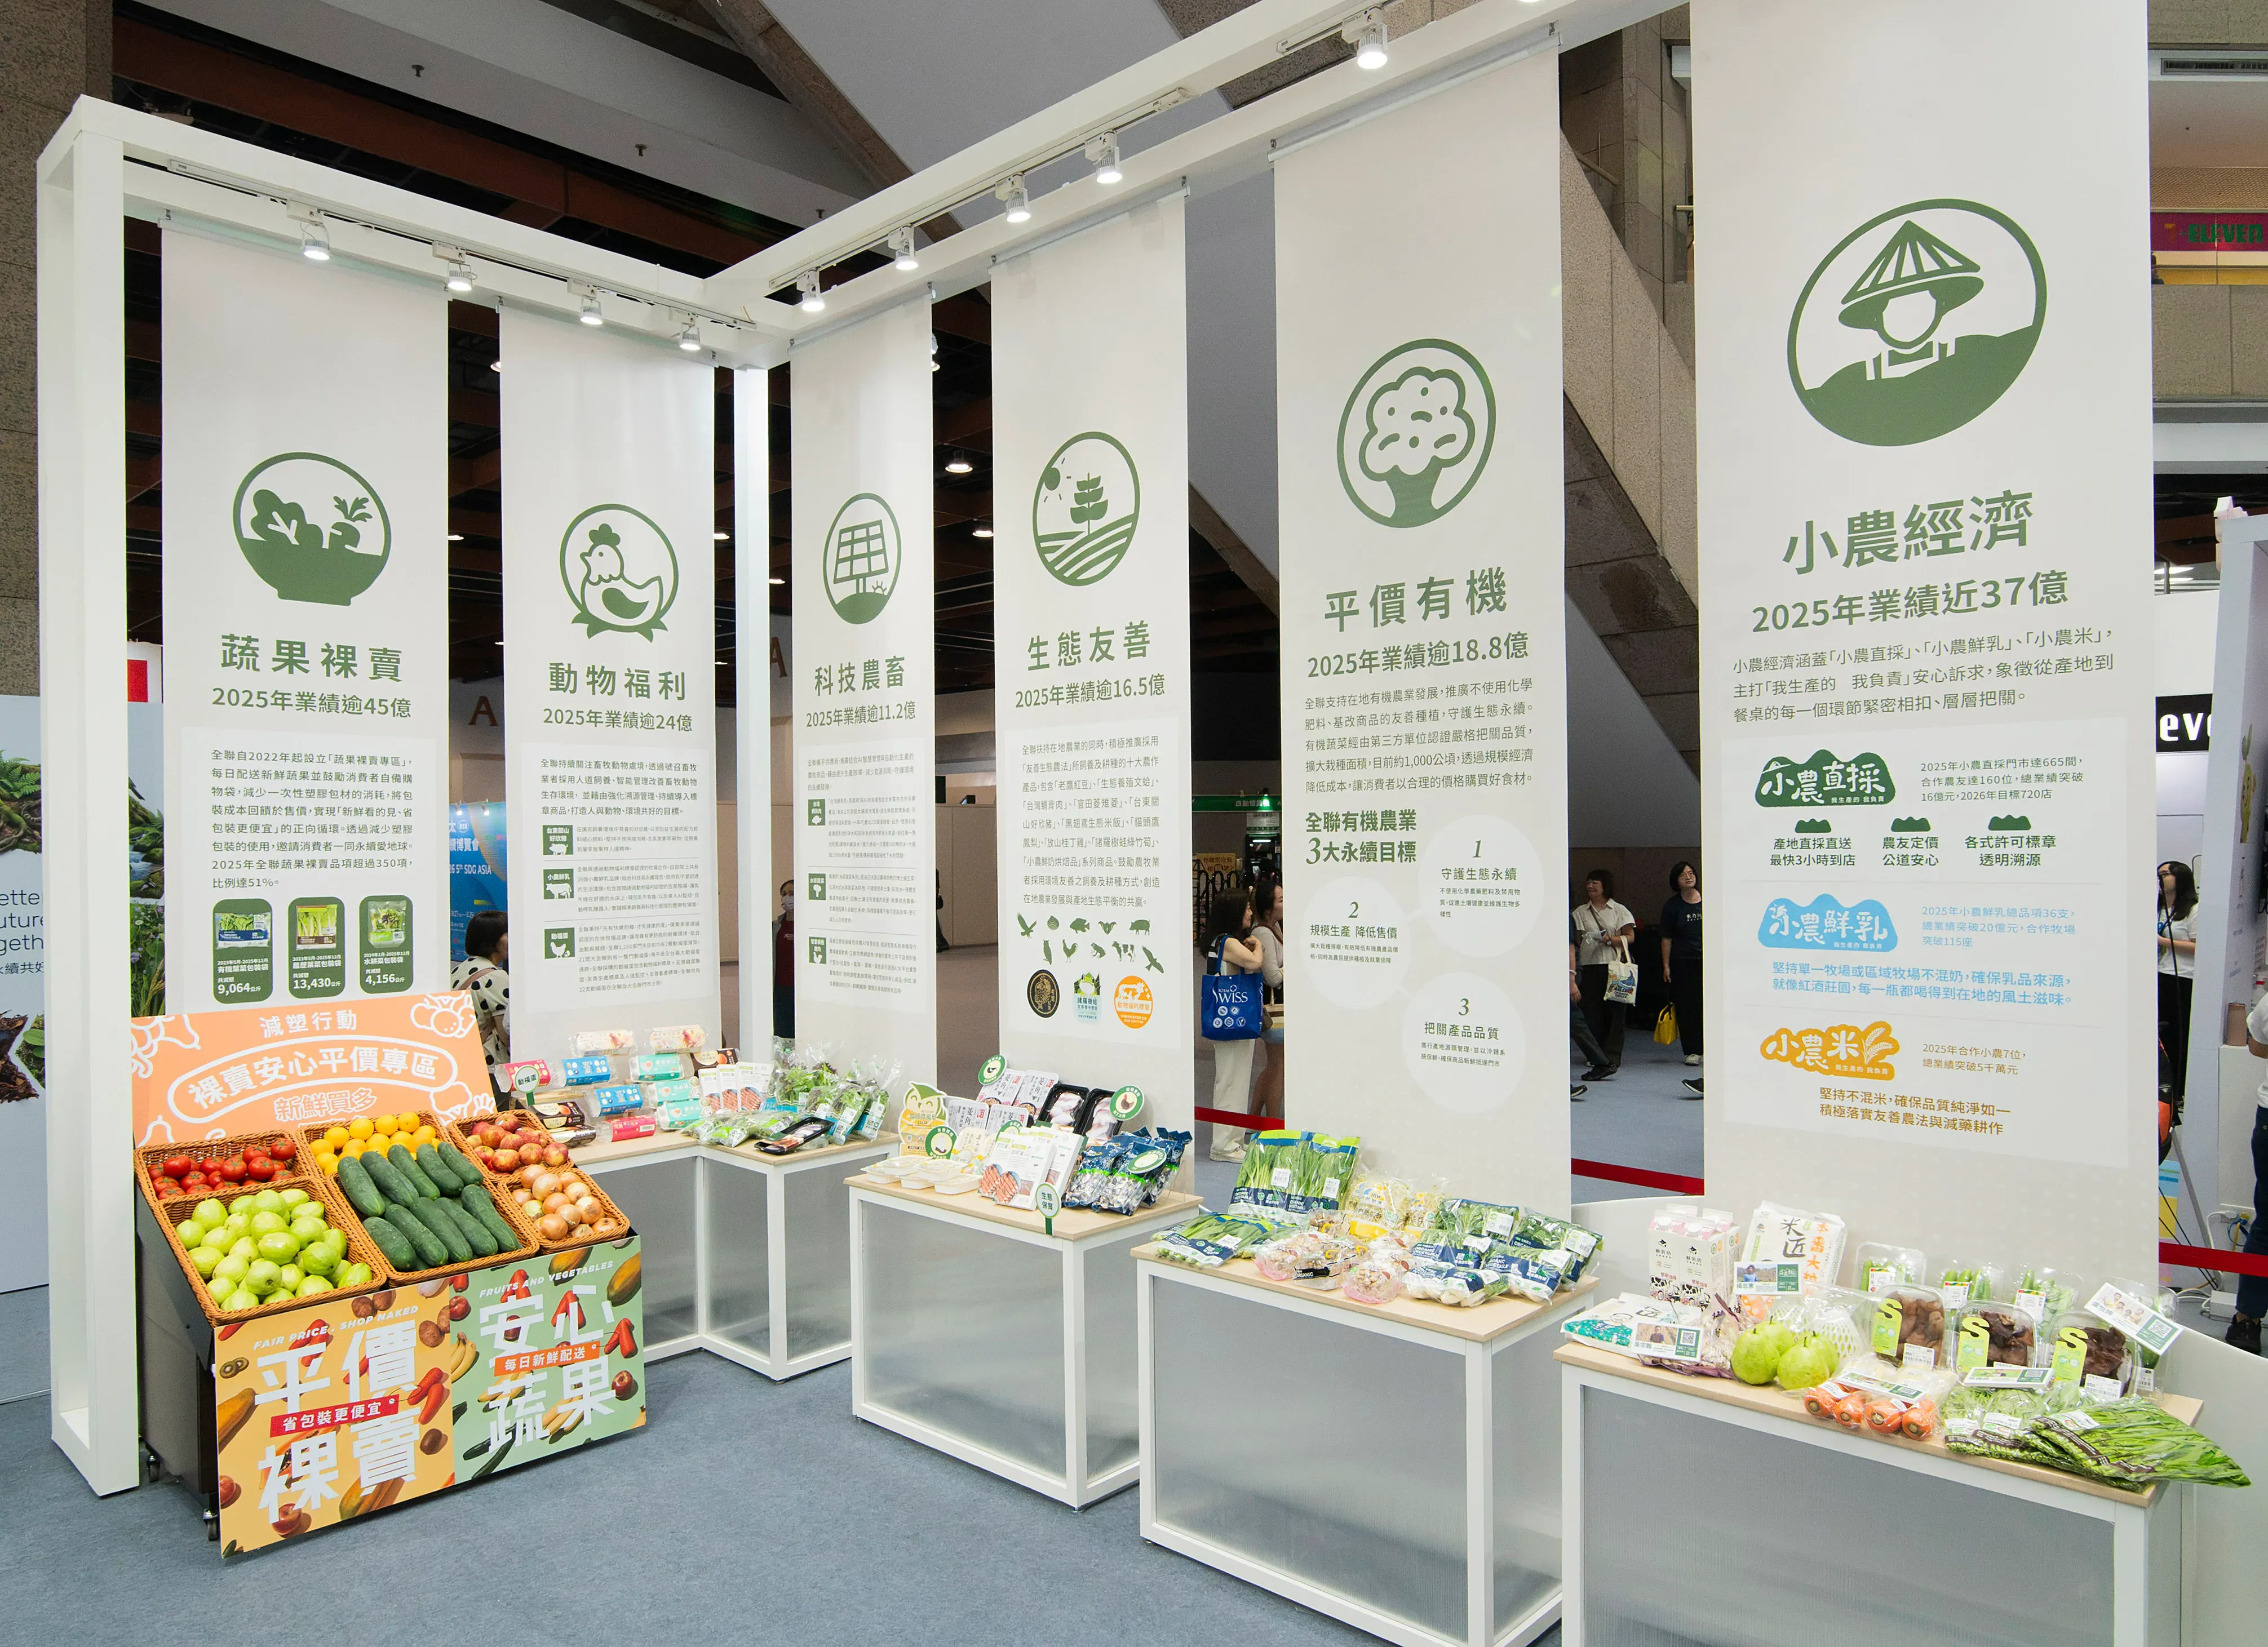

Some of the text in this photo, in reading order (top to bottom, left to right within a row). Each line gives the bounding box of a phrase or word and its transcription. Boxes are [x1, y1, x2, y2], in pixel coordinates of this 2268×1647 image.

[1783, 489, 2034, 575] 小農經濟
[1325, 566, 1507, 633] 平價有機
[1752, 570, 2068, 633] 2025年業績近37億
[221, 634, 402, 682] 蔬果裸賣
[1027, 620, 1150, 671] 生態友善
[1308, 631, 1529, 677] 2025年業績逾18.8億
[549, 662, 686, 701] 動物福利
[814, 655, 905, 696] 科技農畜
[1015, 673, 1165, 708] 2025年業績逾16.5億
[212, 687, 411, 718] 2025年業績逾45億
[468, 696, 499, 727] A
[806, 700, 916, 727] 2025年業績逾11.2億
[1734, 690, 2028, 722] 餐桌的每一個環節緊密相扣、層層把關。
[543, 708, 692, 733] 2025年業績逾24億
[211, 769, 413, 784] 每日配送新鮮蔬果並鼓勵消費者自備購
[1760, 760, 1886, 805] 小農直採
[1305, 809, 1417, 833] 全聯有機農業
[1305, 837, 1417, 864] 3大永續目標
[1473, 840, 1482, 858] 1
[1774, 837, 1851, 850] 產地直採直送
[1882, 836, 1939, 850] 農友定價
[1964, 834, 2057, 849] 各式許可標章
[464, 864, 476, 874] SDG
[477, 864, 492, 874] ASIA
[1442, 867, 1517, 881] 守護生態永續
[1770, 854, 1855, 867] 最快3小時到店
[1883, 853, 1939, 867] 公道安心
[1979, 853, 2041, 867] 透明溯源
[0, 890, 40, 905] ette
[1348, 902, 1359, 918] 2
[1310, 924, 1398, 939] 規模生產 降低售價
[1769, 906, 1888, 945] 小農鮮乳
[0, 935, 43, 955] geth
[1459, 998, 1470, 1016] 3
[259, 1009, 357, 1038] 減塑行動
[1424, 1022, 1499, 1040] 把關產品品質
[1766, 1030, 1861, 1070] 小農米
[188, 1046, 440, 1109] 裸賣安心平價專區
[1923, 1058, 2018, 1075] 總業績突破5千萬元
[1820, 1104, 2004, 1135] 積極落實友善農法與減藥耕作
[1780, 1217, 1806, 1258] 米匠
[479, 1260, 614, 1298] FRUITS AND VEGETABLES
[253, 1306, 419, 1351] FAIR PRICE SHOP NAKED
[479, 1285, 615, 1368] 安心
[254, 1319, 418, 1415] 平價
[504, 1346, 586, 1371] 每日新鮮配送
[282, 1400, 382, 1432] 省包裝更便宜
[488, 1356, 616, 1453] 蔬果
[258, 1406, 420, 1524] 裸賣
